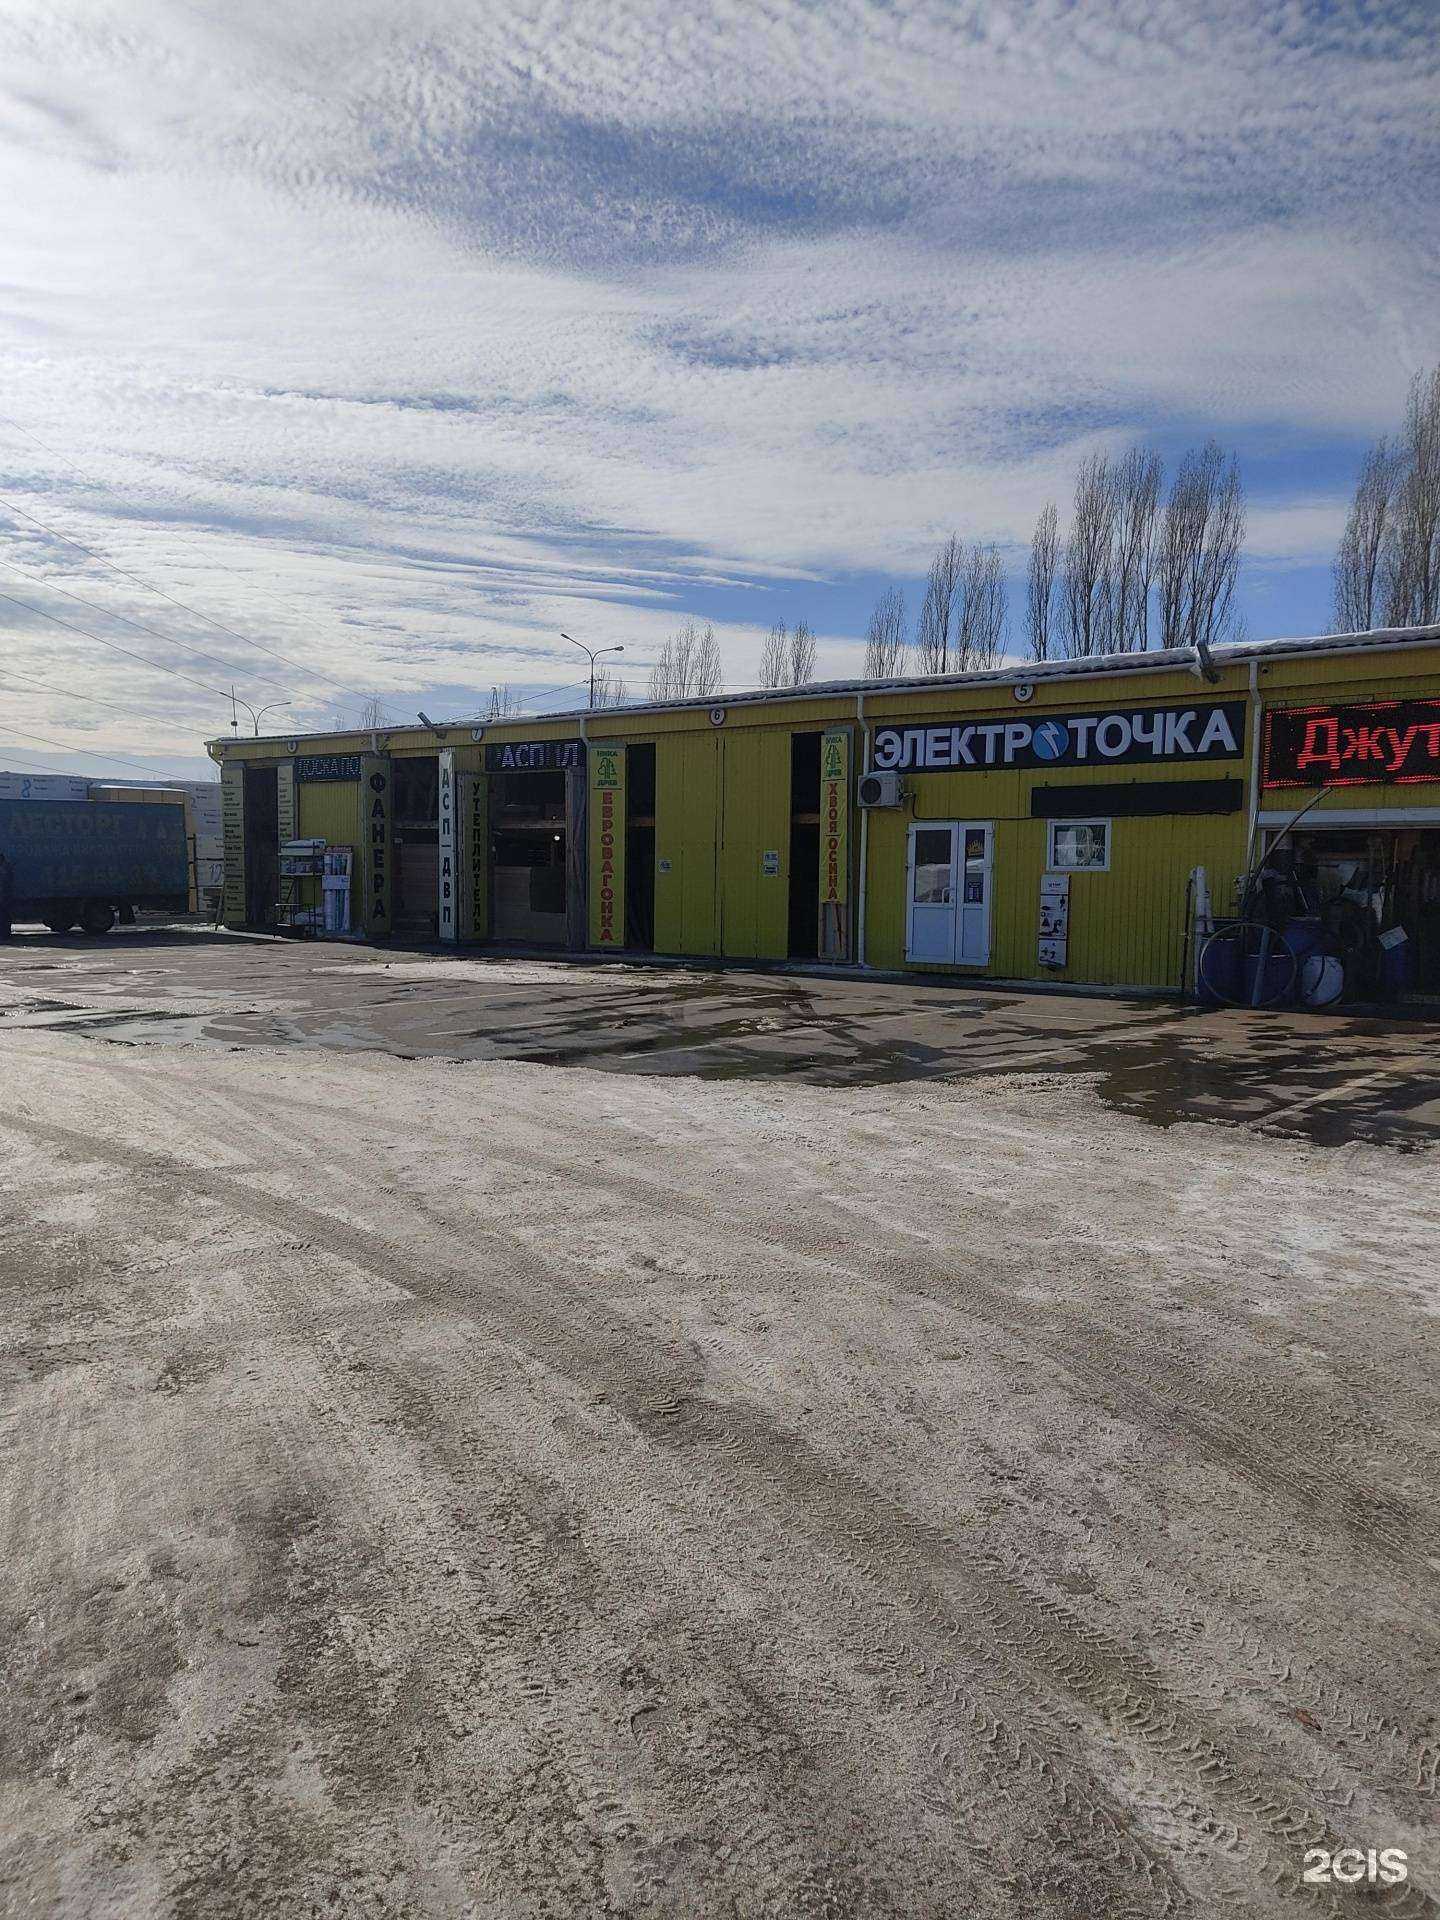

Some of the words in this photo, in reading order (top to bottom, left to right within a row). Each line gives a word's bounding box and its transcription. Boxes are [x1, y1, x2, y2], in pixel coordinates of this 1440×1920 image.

[1019, 685, 1028, 697] 5
[369, 772, 387, 920] ФАНЕРА
[472, 781, 482, 932] УТЕПЛИТЕЛЬ
[827, 782, 838, 833] ХВОЯ
[600, 791, 614, 942] ЕВРОВАГОНКА
[827, 837, 839, 900] ОСИНА
